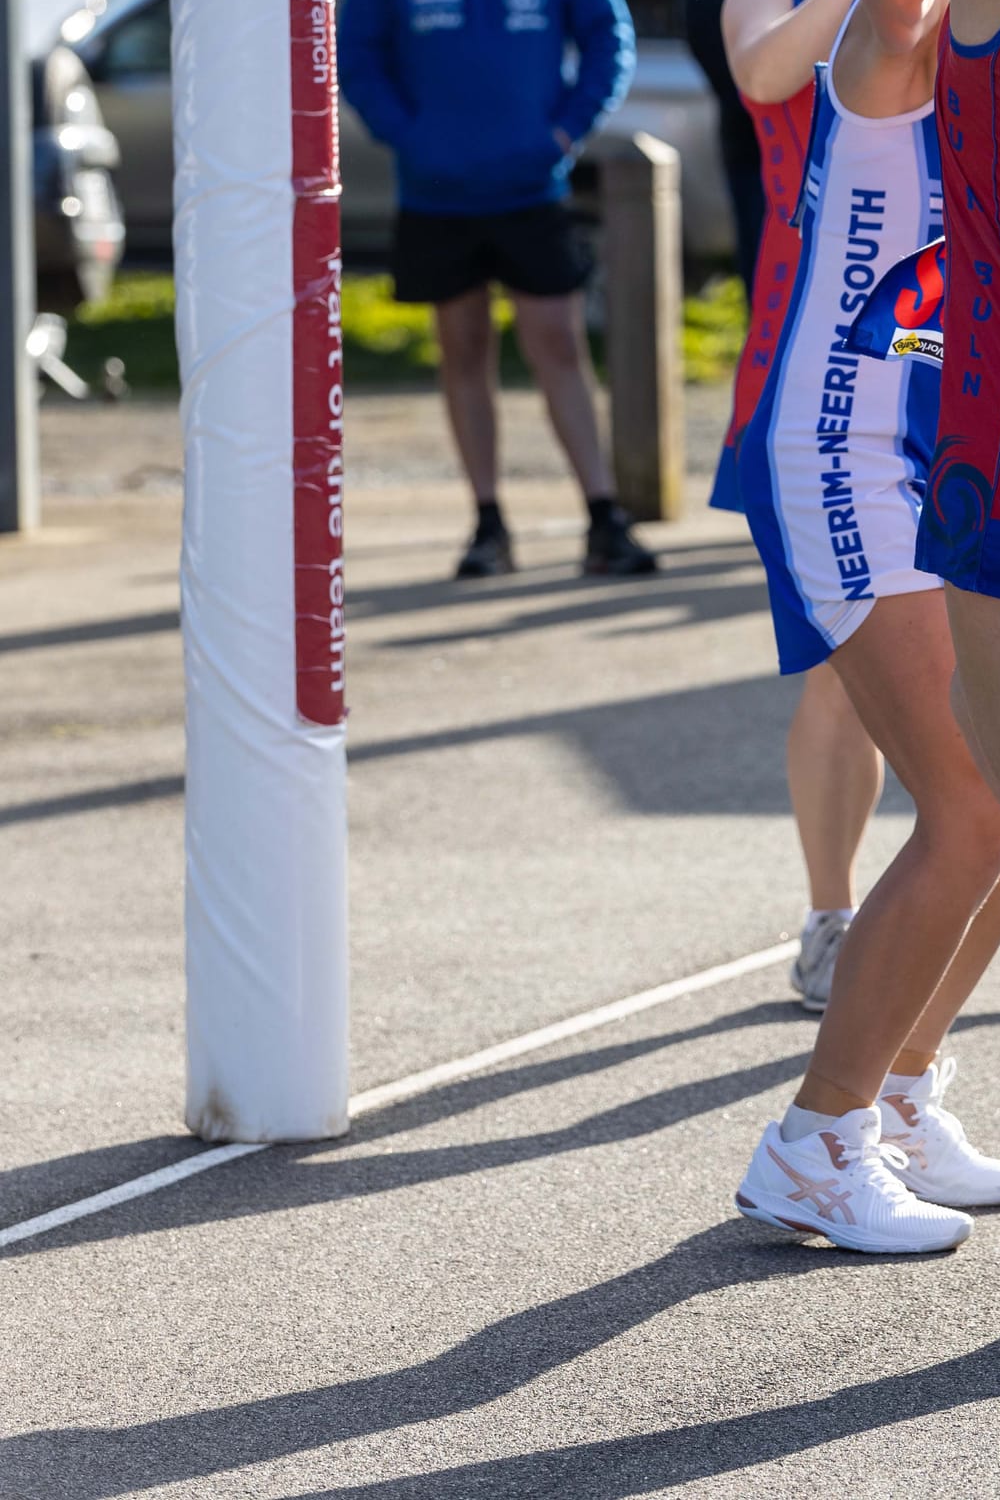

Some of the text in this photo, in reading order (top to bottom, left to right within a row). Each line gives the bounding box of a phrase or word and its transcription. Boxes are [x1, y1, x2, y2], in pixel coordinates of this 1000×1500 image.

[817, 188, 886, 601] NEERIM-NEERIM SOUTH
[946, 87, 993, 397] BUN BULN
[329, 557, 345, 692] team
